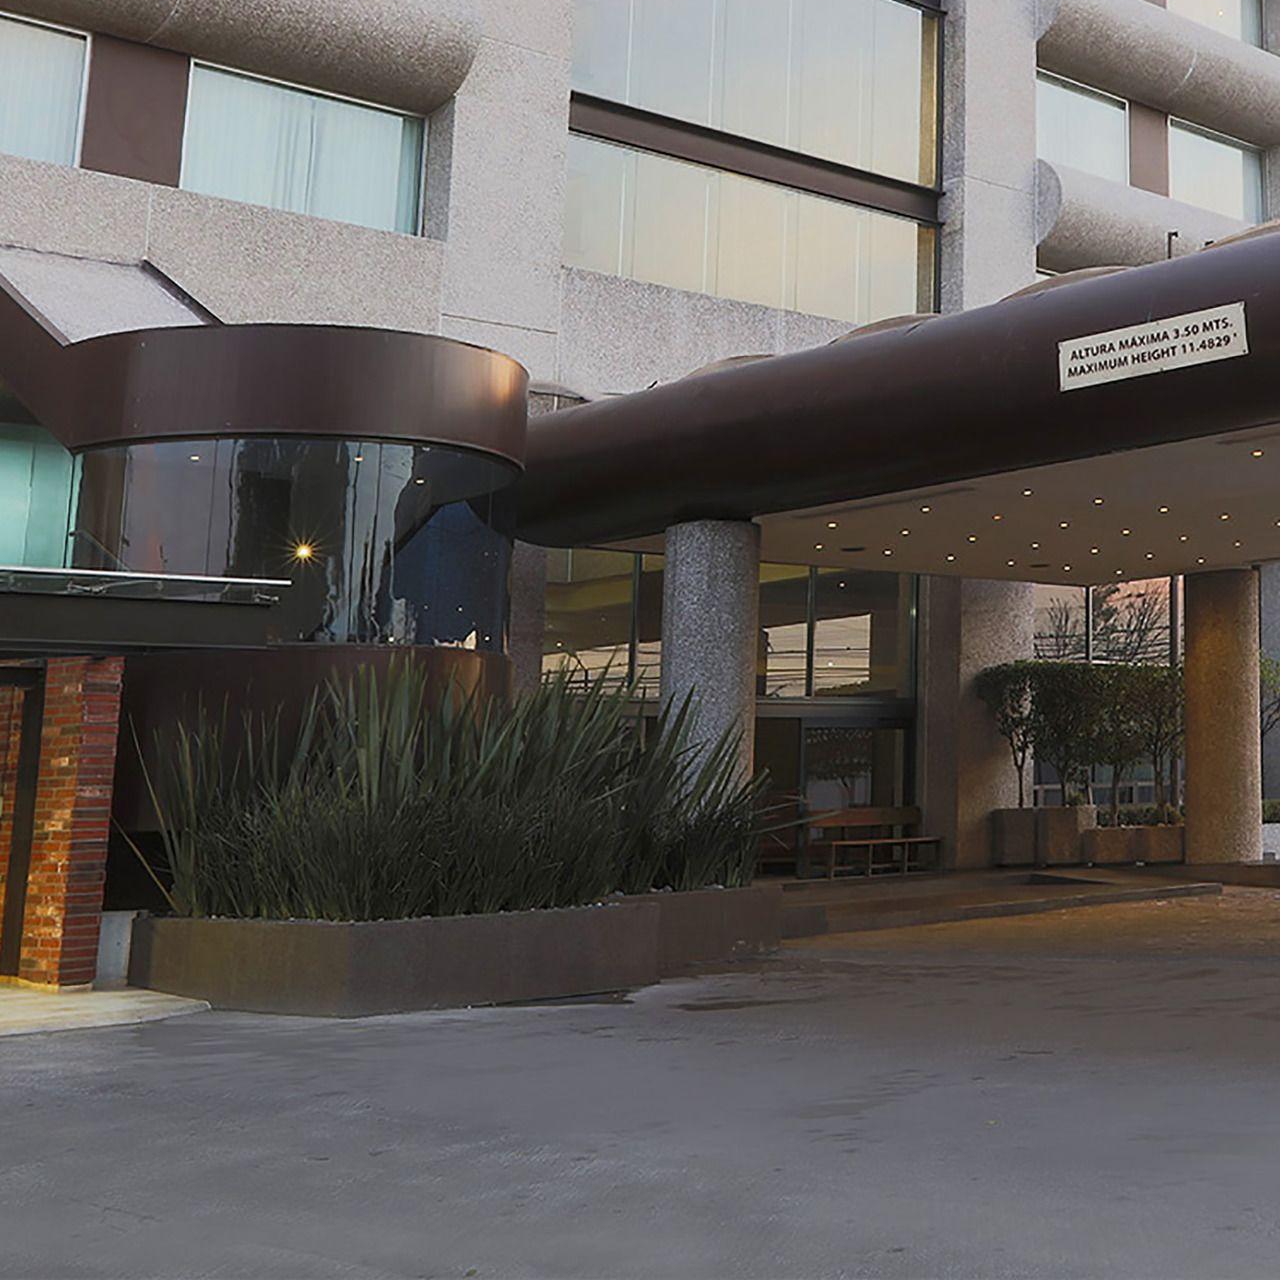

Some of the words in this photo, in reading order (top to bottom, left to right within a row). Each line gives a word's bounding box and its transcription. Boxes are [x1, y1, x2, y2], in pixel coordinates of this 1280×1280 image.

[1070, 342, 1116, 361] ALTURA
[1118, 330, 1170, 351] MAXIMA
[1173, 324, 1199, 339] 3.50
[1202, 316, 1233, 333] MTS.
[1067, 355, 1129, 378] MAXIMUM
[1131, 345, 1177, 365] HEIGHT
